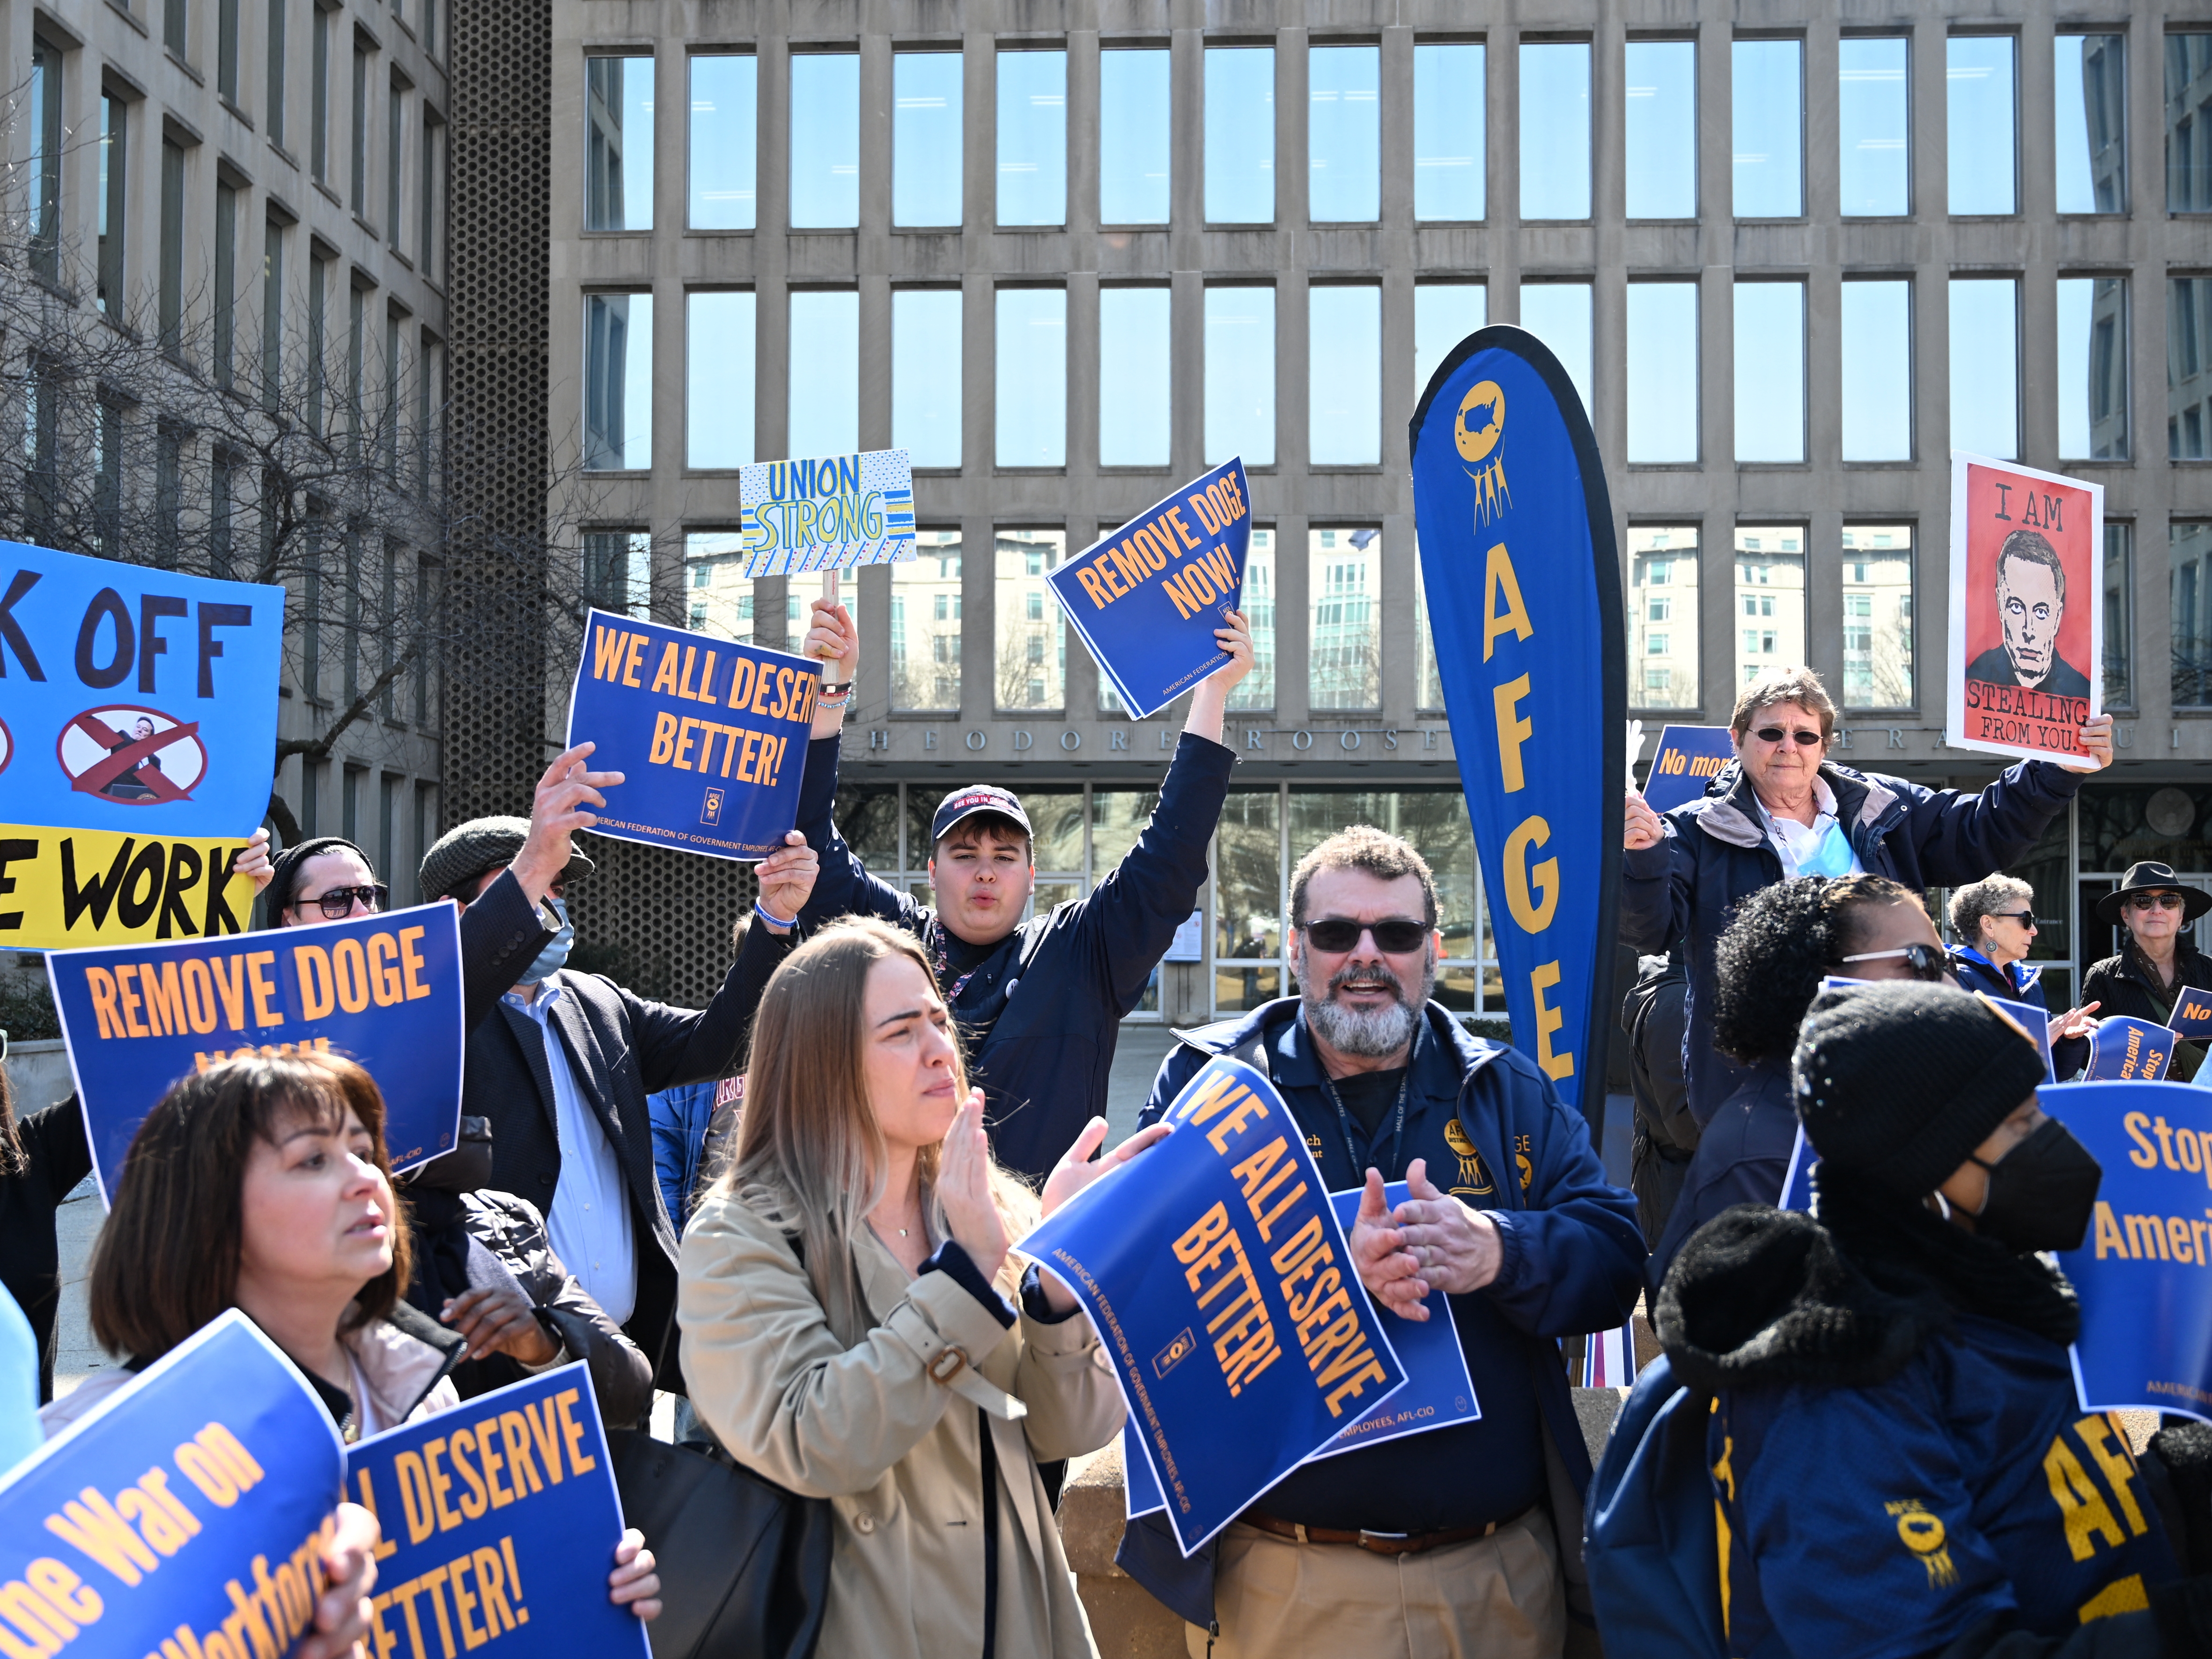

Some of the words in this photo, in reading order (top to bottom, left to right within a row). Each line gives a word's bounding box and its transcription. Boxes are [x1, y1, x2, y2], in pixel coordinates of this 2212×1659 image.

[769, 455, 859, 500] UNION
[1995, 483, 2013, 521] I
[2022, 491, 2064, 532] AM
[753, 491, 882, 552] STRONG
[1076, 505, 1202, 610] REMOVE
[1188, 471, 1246, 537] DOGE
[1161, 543, 1240, 620] NOW!
[74, 587, 252, 698] OFF
[594, 625, 649, 688] WE
[651, 641, 717, 704] ALL
[728, 657, 821, 724] DESERV
[1163, 673, 1193, 696] AMERICAN
[1193, 650, 1228, 676] FEDERATION
[1967, 681, 2088, 726] STEALING
[1980, 716, 2031, 745] FROM
[2039, 726, 2078, 752] YOU.
[649, 711, 787, 786] BETTER!
[870, 730, 1172, 751] HEODORE
[1246, 730, 1438, 751] ROOSE
[1658, 748, 1687, 775] No
[1689, 756, 1730, 777] mor
[627, 823, 676, 838] FEDERATION
[690, 835, 741, 850] GOVERNMENT
[1482, 541, 1574, 1082] AFGE
[60, 837, 249, 940] WORK
[85, 950, 284, 1040] REMOVE
[293, 925, 430, 1021] DOGE
[2183, 1002, 2211, 1020] No
[2120, 1026, 2144, 1080] America
[1334, 1096, 1346, 1118] STATES
[1397, 1104, 1404, 1114] OF
[1177, 1069, 1269, 1156] WE
[1231, 1135, 1309, 1244] ALL
[1271, 1215, 1388, 1418] DESERVE
[1052, 1247, 1101, 1297] AMERICAN
[1096, 1294, 1130, 1356] FEDERATION
[1123, 1353, 1135, 1367] OF
[1171, 1200, 1283, 1398] BETTER!
[1397, 1406, 1435, 1423] AFL-CIO
[394, 1387, 596, 1546] DESERVE
[44, 1466, 202, 1587] War
[173, 1421, 265, 1508] on
[359, 1535, 530, 1659] ETTER!
